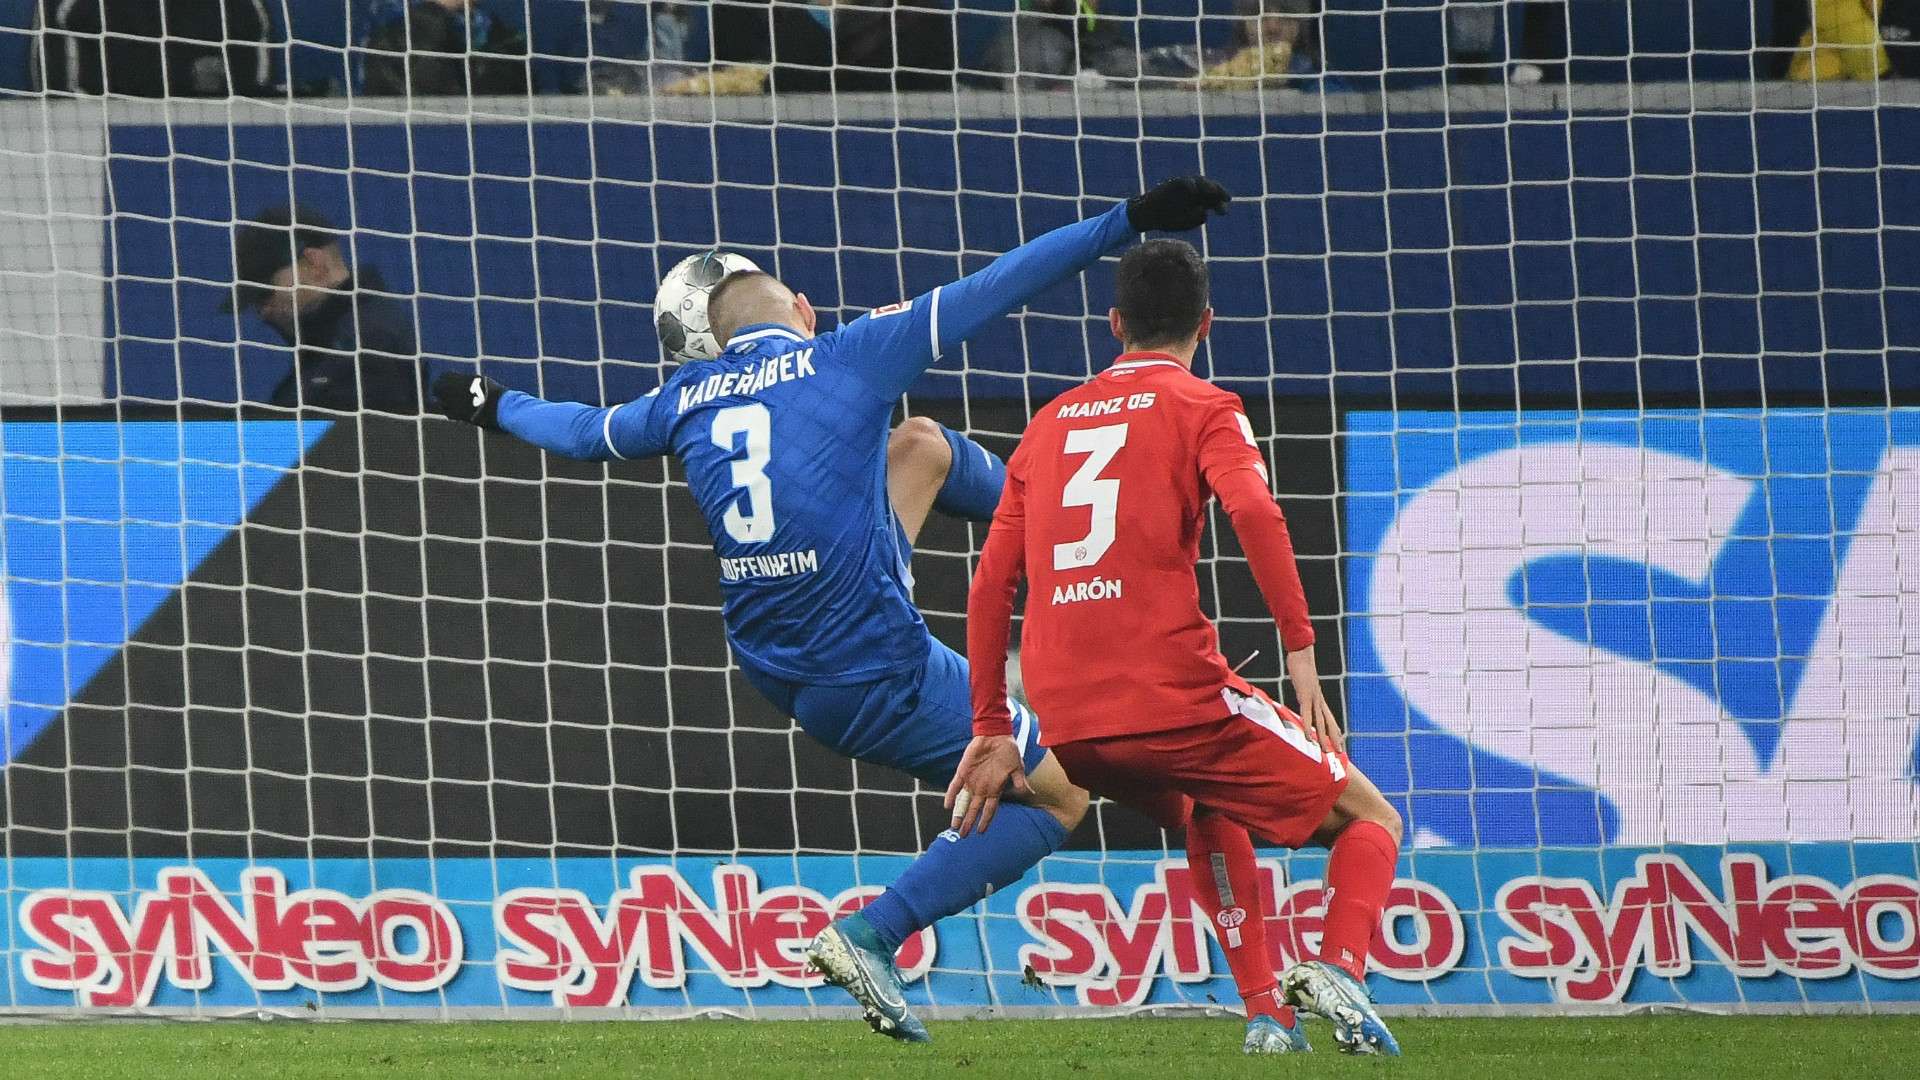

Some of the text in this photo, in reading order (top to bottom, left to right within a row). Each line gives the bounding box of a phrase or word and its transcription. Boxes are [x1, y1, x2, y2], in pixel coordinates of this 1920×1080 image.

[677, 348, 816, 415] KADEŘÁBEK
[1056, 392, 1157, 419] MAINZ 05
[711, 403, 776, 545] 3
[1054, 422, 1129, 571] 3
[1052, 575, 1122, 605] AARÓN
